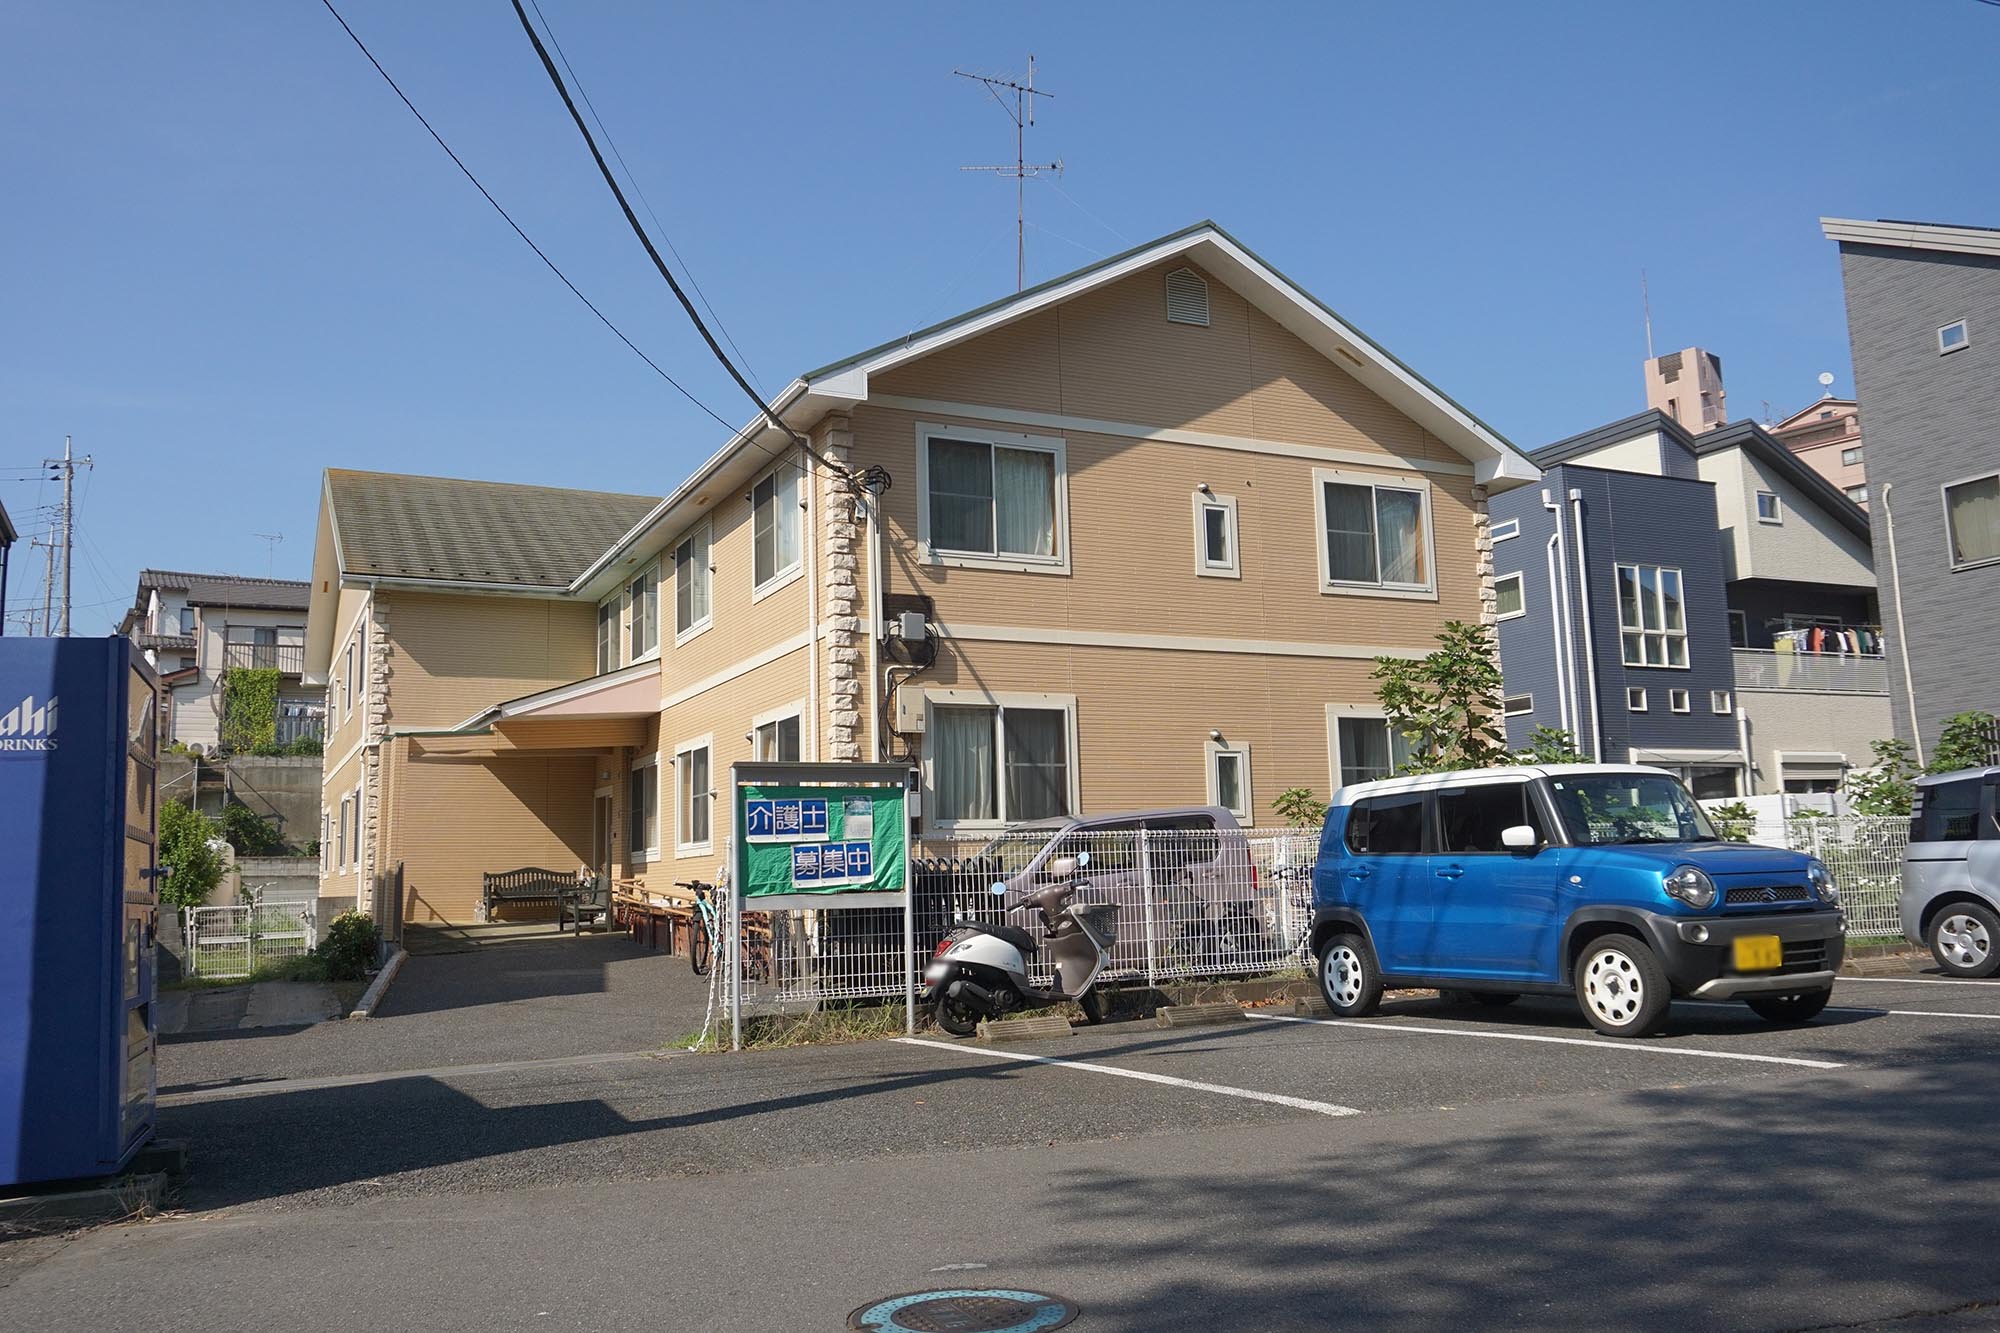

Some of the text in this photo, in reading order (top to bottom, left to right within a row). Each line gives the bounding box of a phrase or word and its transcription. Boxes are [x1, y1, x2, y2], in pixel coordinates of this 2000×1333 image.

[749, 804, 826, 831] 介護士
[795, 847, 869, 876] 募集中
